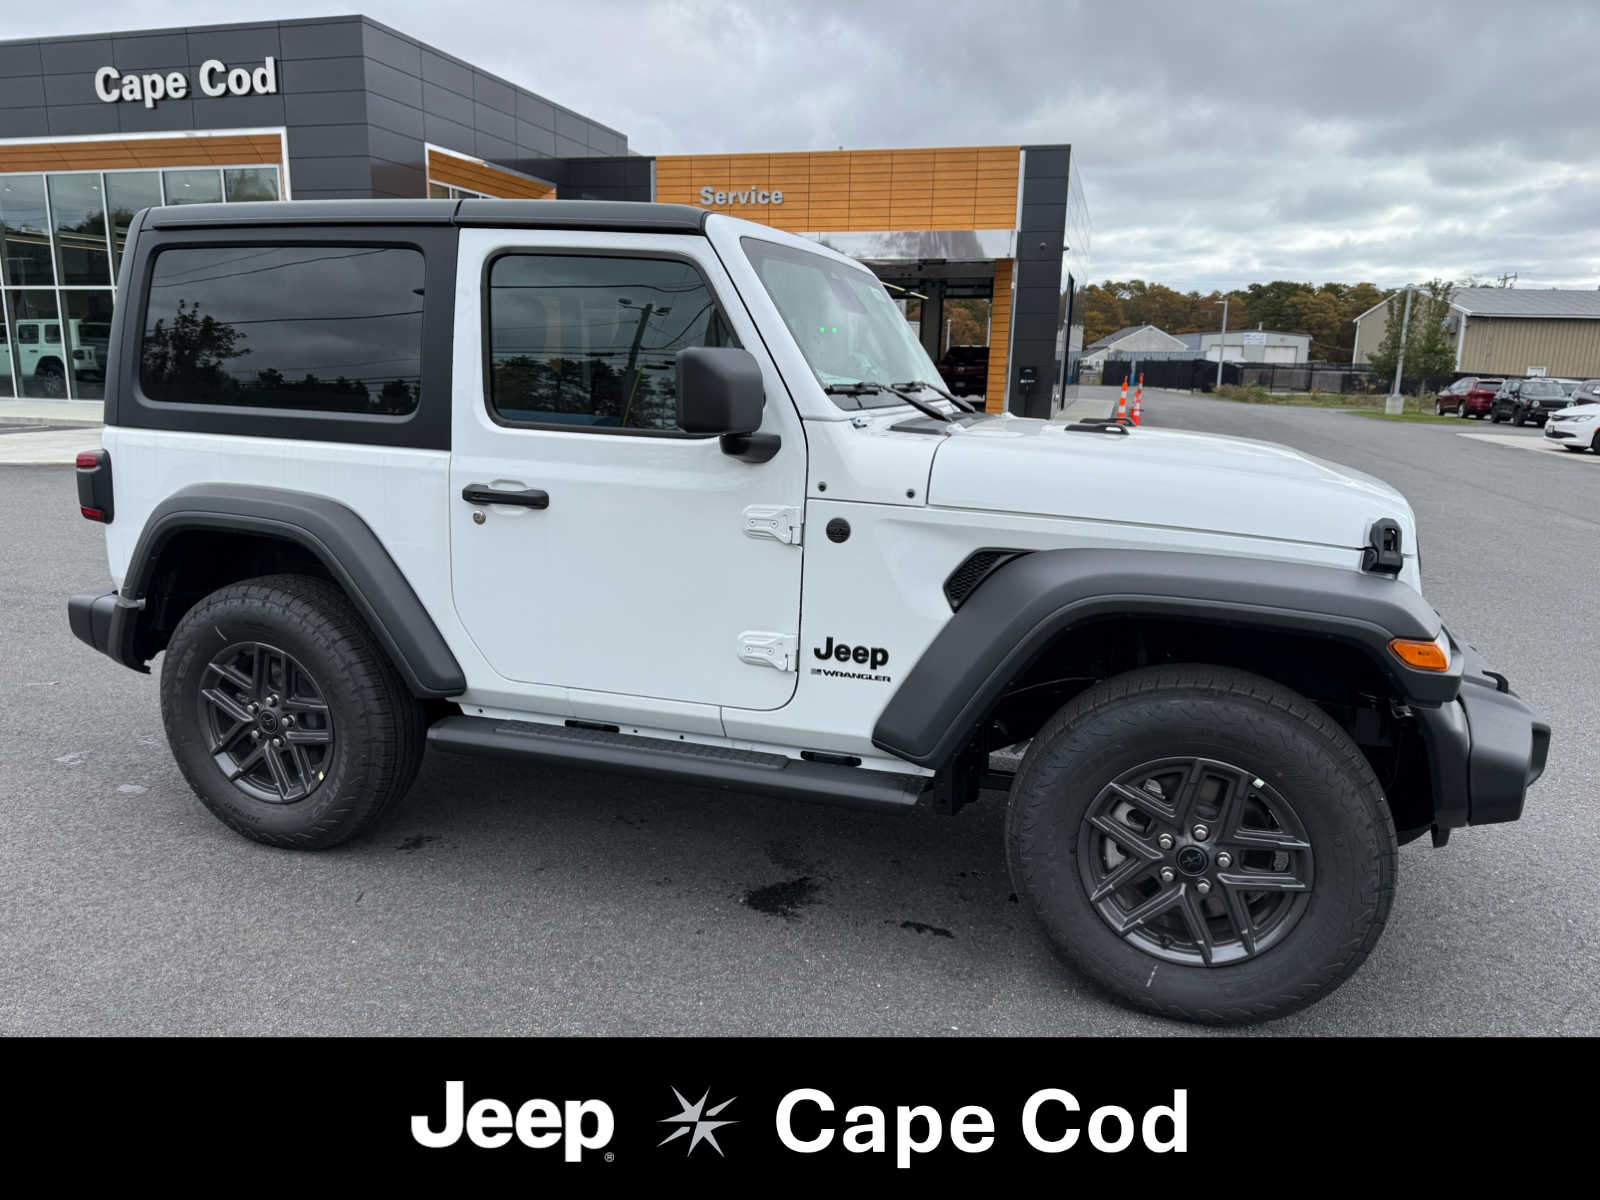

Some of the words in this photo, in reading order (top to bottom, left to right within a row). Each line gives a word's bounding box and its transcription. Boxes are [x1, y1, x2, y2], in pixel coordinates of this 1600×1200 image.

[94, 65, 188, 109] Cape
[198, 55, 278, 97] Cod
[700, 185, 784, 206] Service
[813, 636, 889, 670] Jeep
[822, 668, 892, 682] WRANGLER
